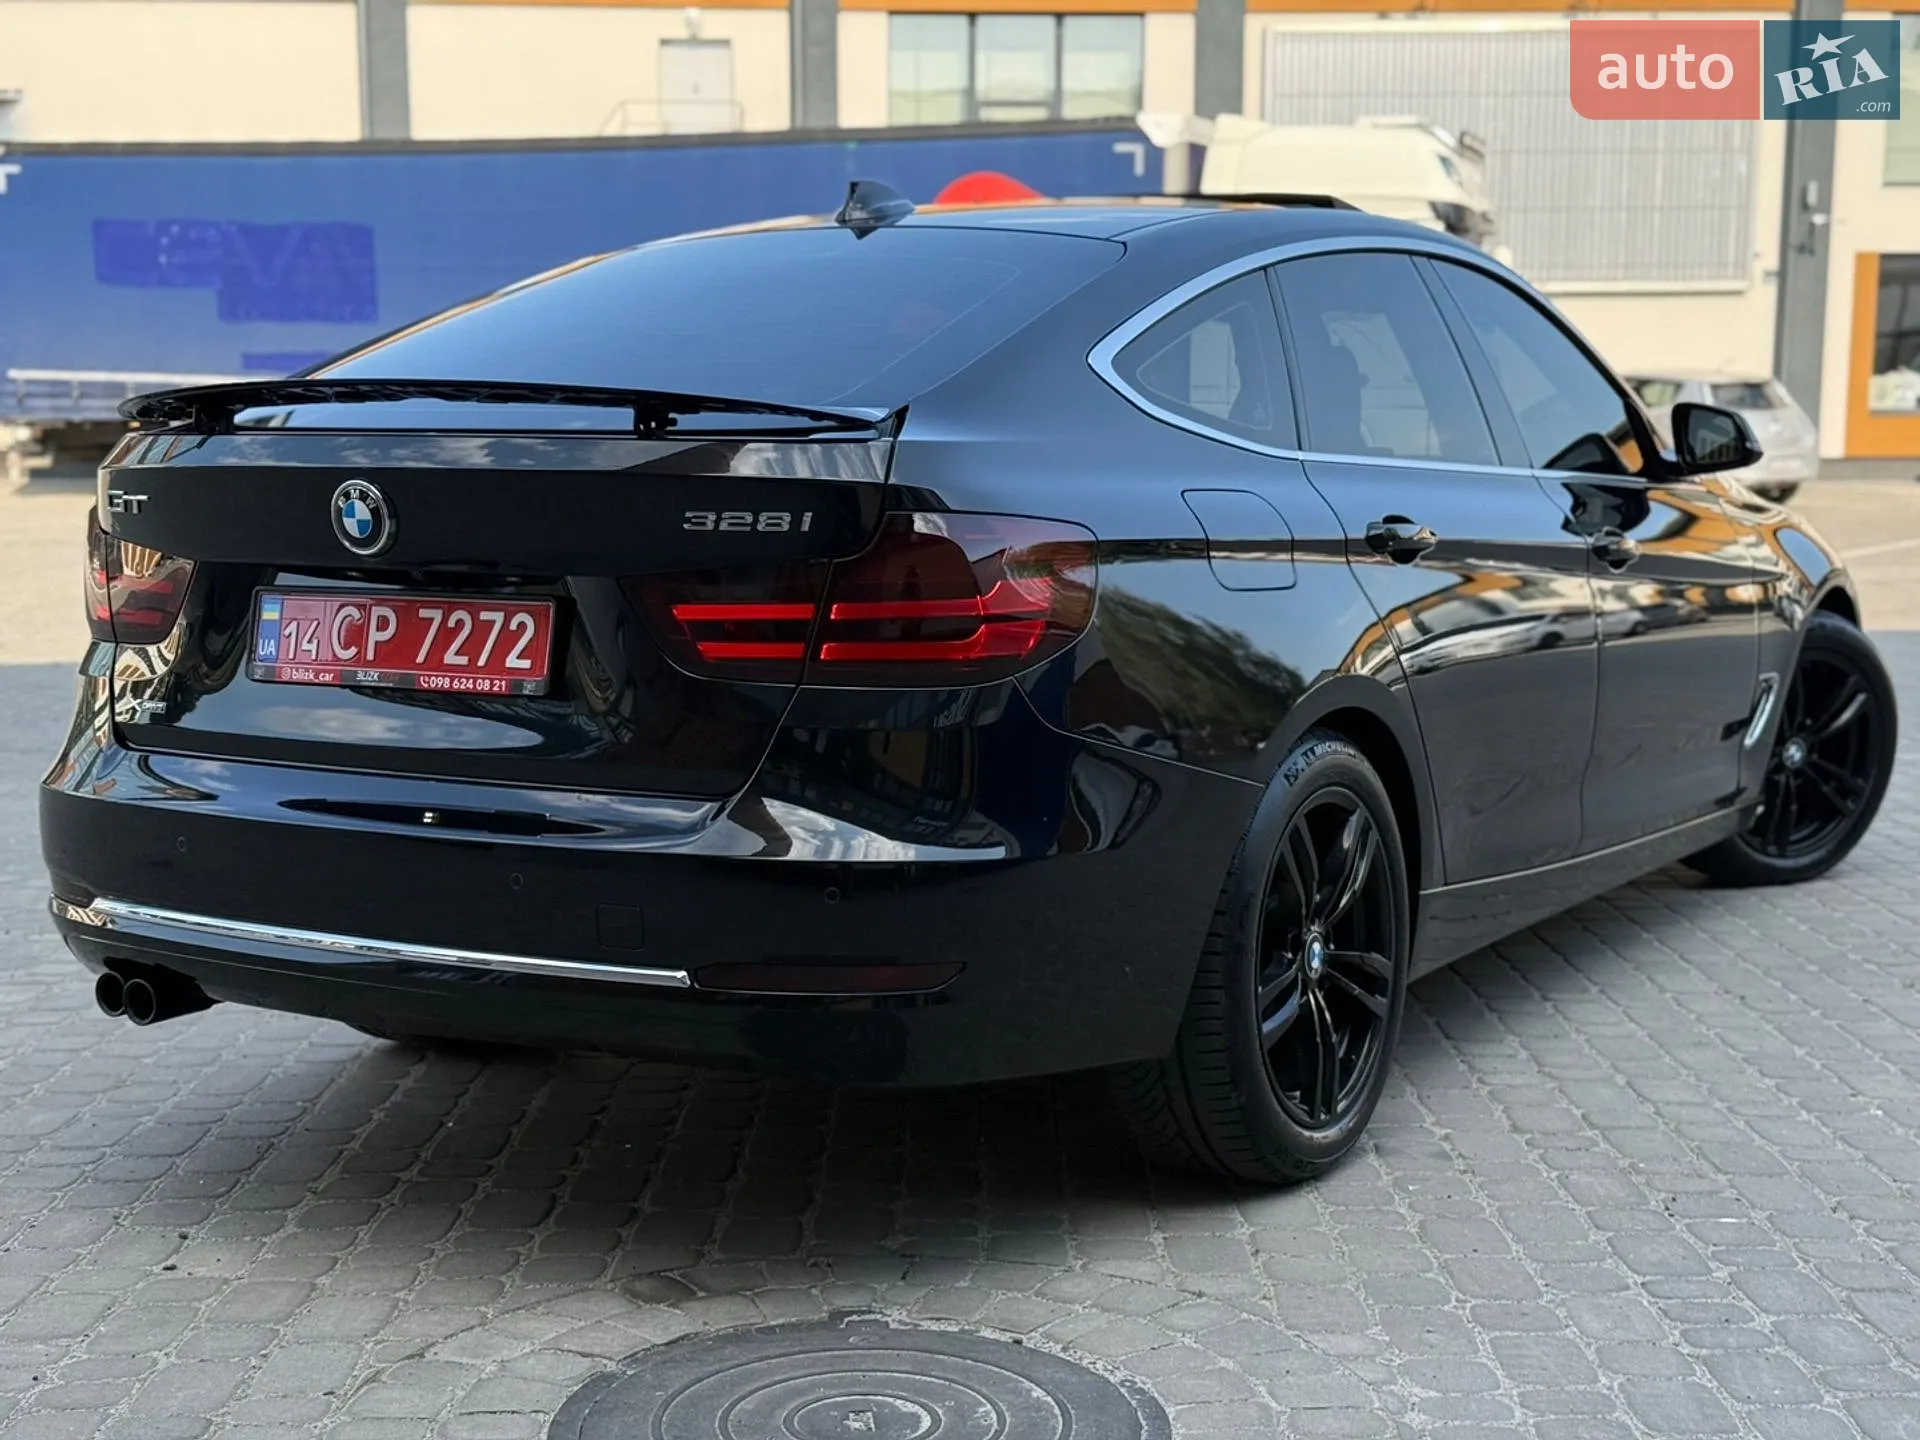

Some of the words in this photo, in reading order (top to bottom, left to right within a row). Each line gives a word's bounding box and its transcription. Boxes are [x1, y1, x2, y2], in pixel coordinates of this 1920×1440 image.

[107, 489, 148, 514] GT
[259, 639, 276, 656] UA
[283, 619, 319, 660] 14
[330, 605, 398, 661] CP
[416, 607, 535, 670] 7272
[429, 675, 450, 688] 098
[452, 678, 474, 690] 624
[475, 679, 491, 691] 08
[492, 680, 507, 691] 21
